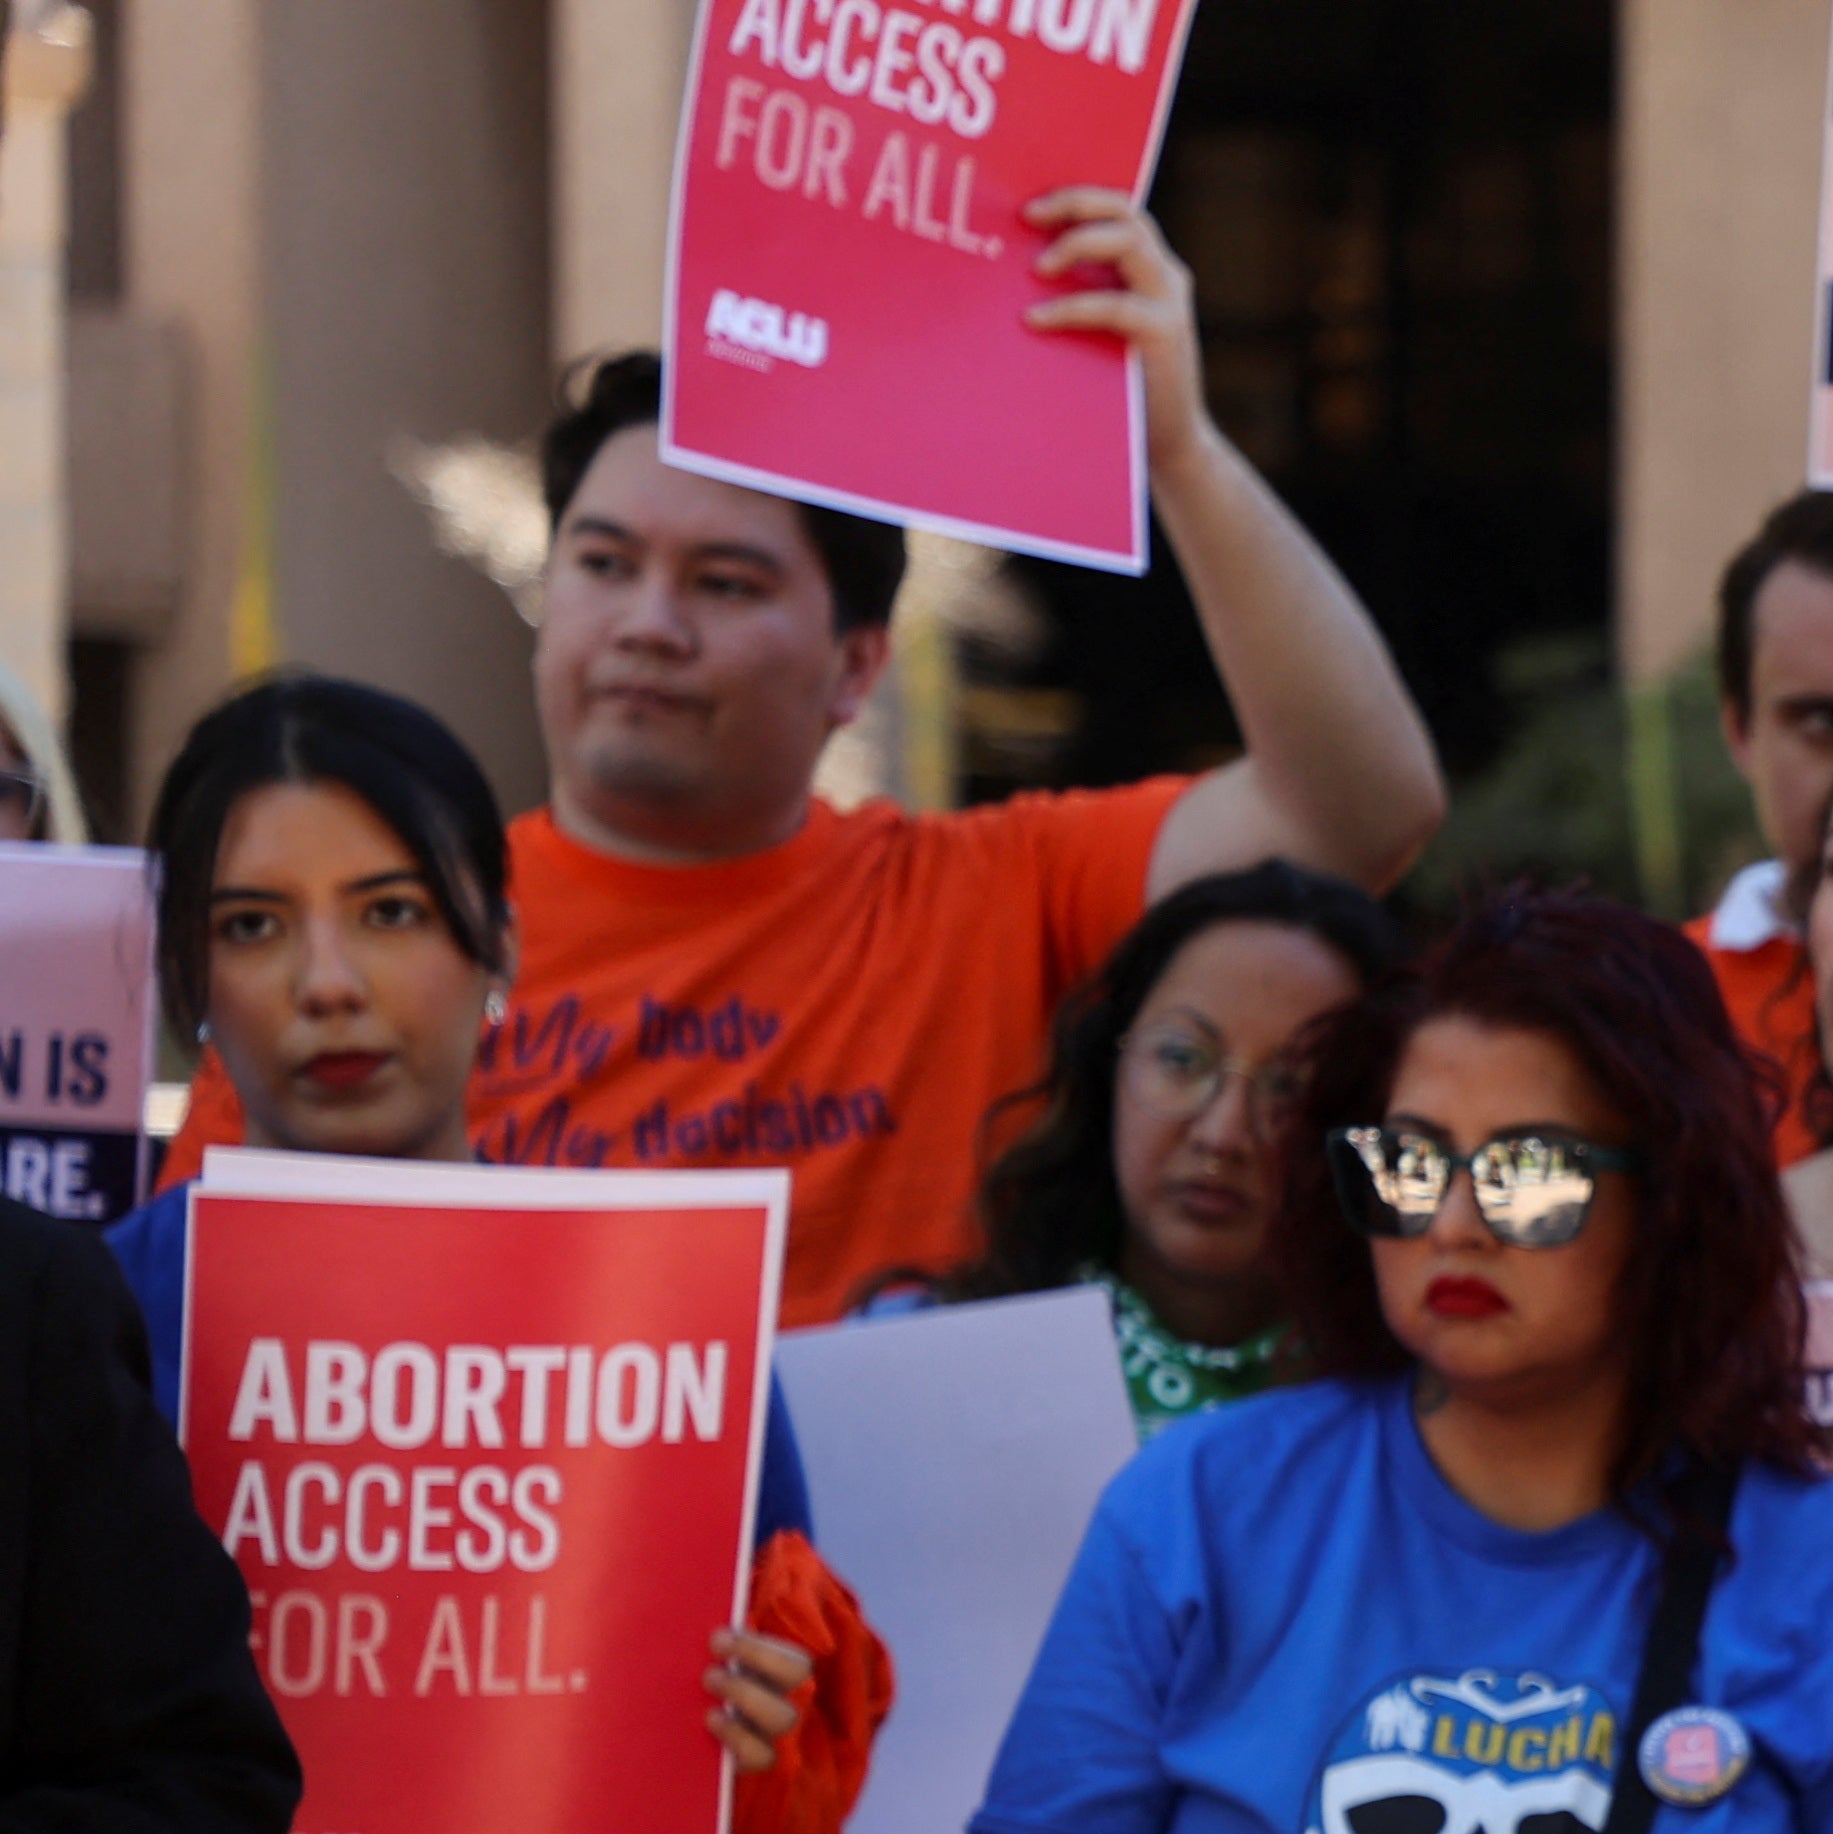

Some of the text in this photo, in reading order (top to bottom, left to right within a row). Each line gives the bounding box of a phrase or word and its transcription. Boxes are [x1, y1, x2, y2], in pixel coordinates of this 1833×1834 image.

[729, 0, 1004, 139] ACCESS
[715, 75, 1003, 260] FOR ALL.
[46, 1030, 109, 1104] IS
[228, 1337, 728, 1449] ABORTION
[222, 1460, 563, 1573] ACCESS
[415, 1592, 588, 1699] ALL.
[1432, 1711, 1615, 1774] LUCHA
